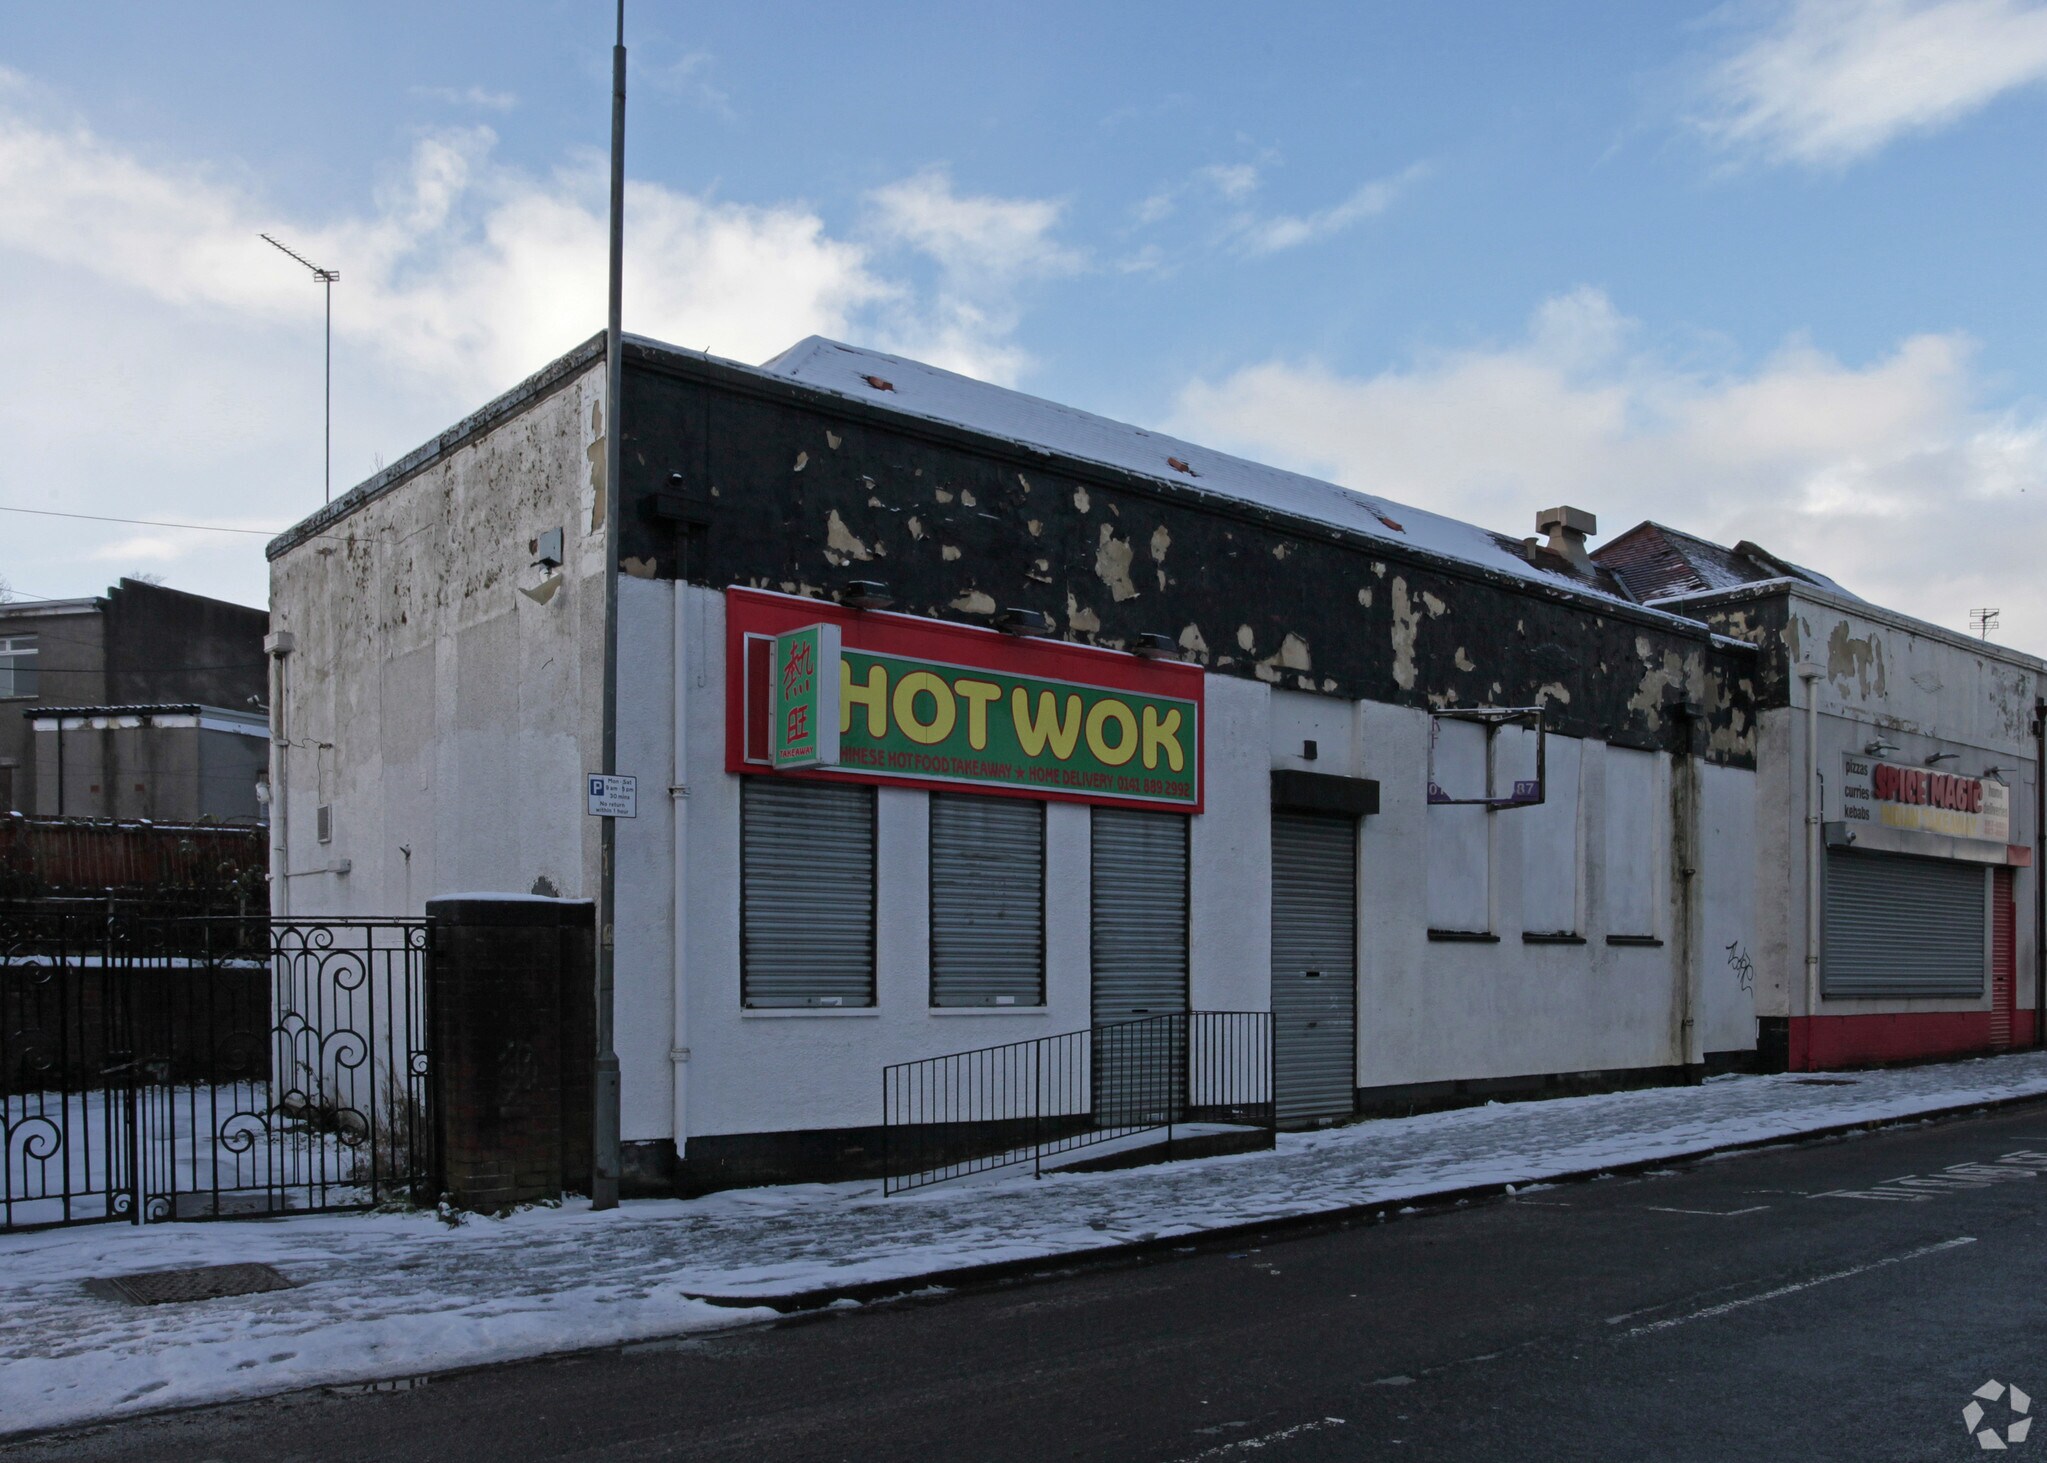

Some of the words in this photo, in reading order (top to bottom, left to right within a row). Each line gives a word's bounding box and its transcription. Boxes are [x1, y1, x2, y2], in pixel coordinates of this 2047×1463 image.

[840, 659, 1002, 751] HOT
[1011, 685, 1185, 773] WOK
[780, 746, 814, 759] TAKEAWAY
[840, 746, 885, 767] HINESE
[888, 751, 913, 769] HOT
[915, 754, 949, 773] FOOD
[951, 757, 1012, 779] TAKEAWAY
[1030, 767, 1060, 784] HOME
[1062, 770, 1115, 790] DELIVERY
[1117, 776, 1141, 793] 0141
[1144, 778, 1163, 794] 889
[1165, 781, 1191, 798] 2992
[1845, 760, 1869, 776] pizzas
[1845, 785, 1870, 800] curries
[1875, 762, 1927, 805] SPICE
[1928, 772, 1983, 814] MAGIC
[1844, 804, 1870, 821] kebabs
